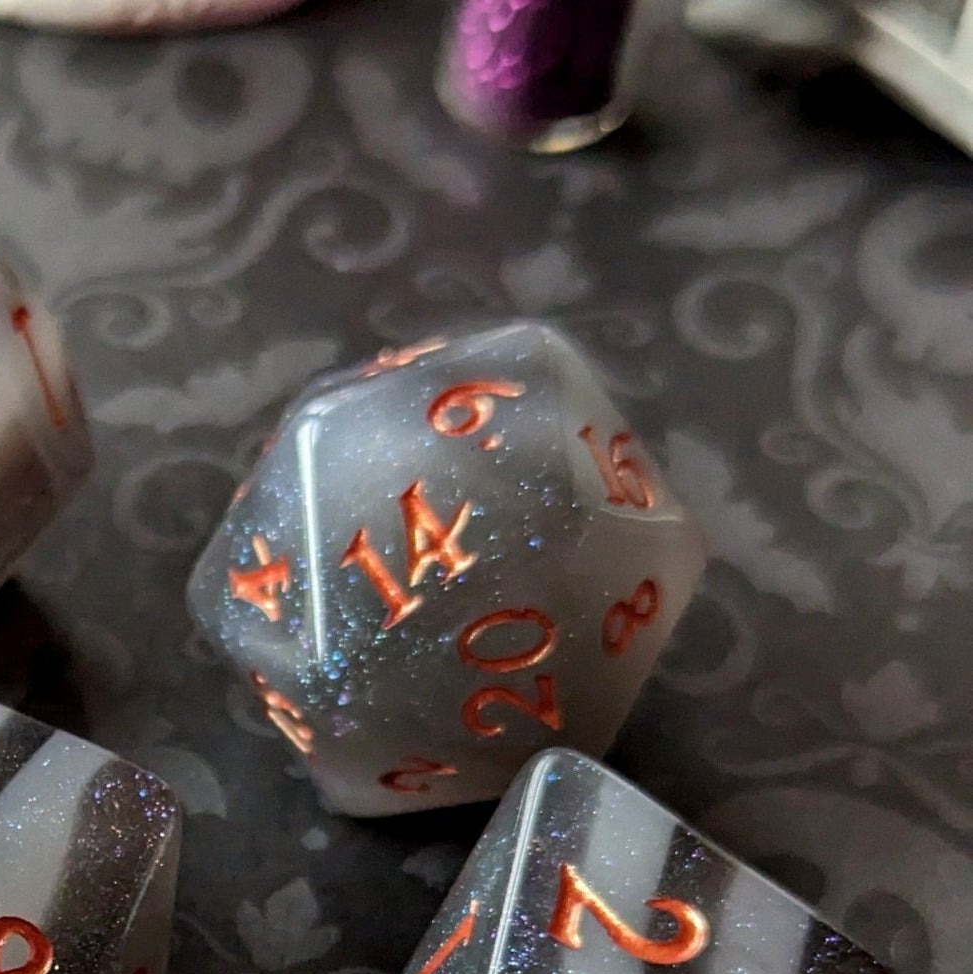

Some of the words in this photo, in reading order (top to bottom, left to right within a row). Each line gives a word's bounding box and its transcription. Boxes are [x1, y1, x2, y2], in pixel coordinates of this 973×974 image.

[230, 538, 290, 620] 4
[340, 480, 478, 631] 14
[603, 579, 663, 656] 8
[458, 607, 562, 737] 20
[547, 863, 708, 966] 2
